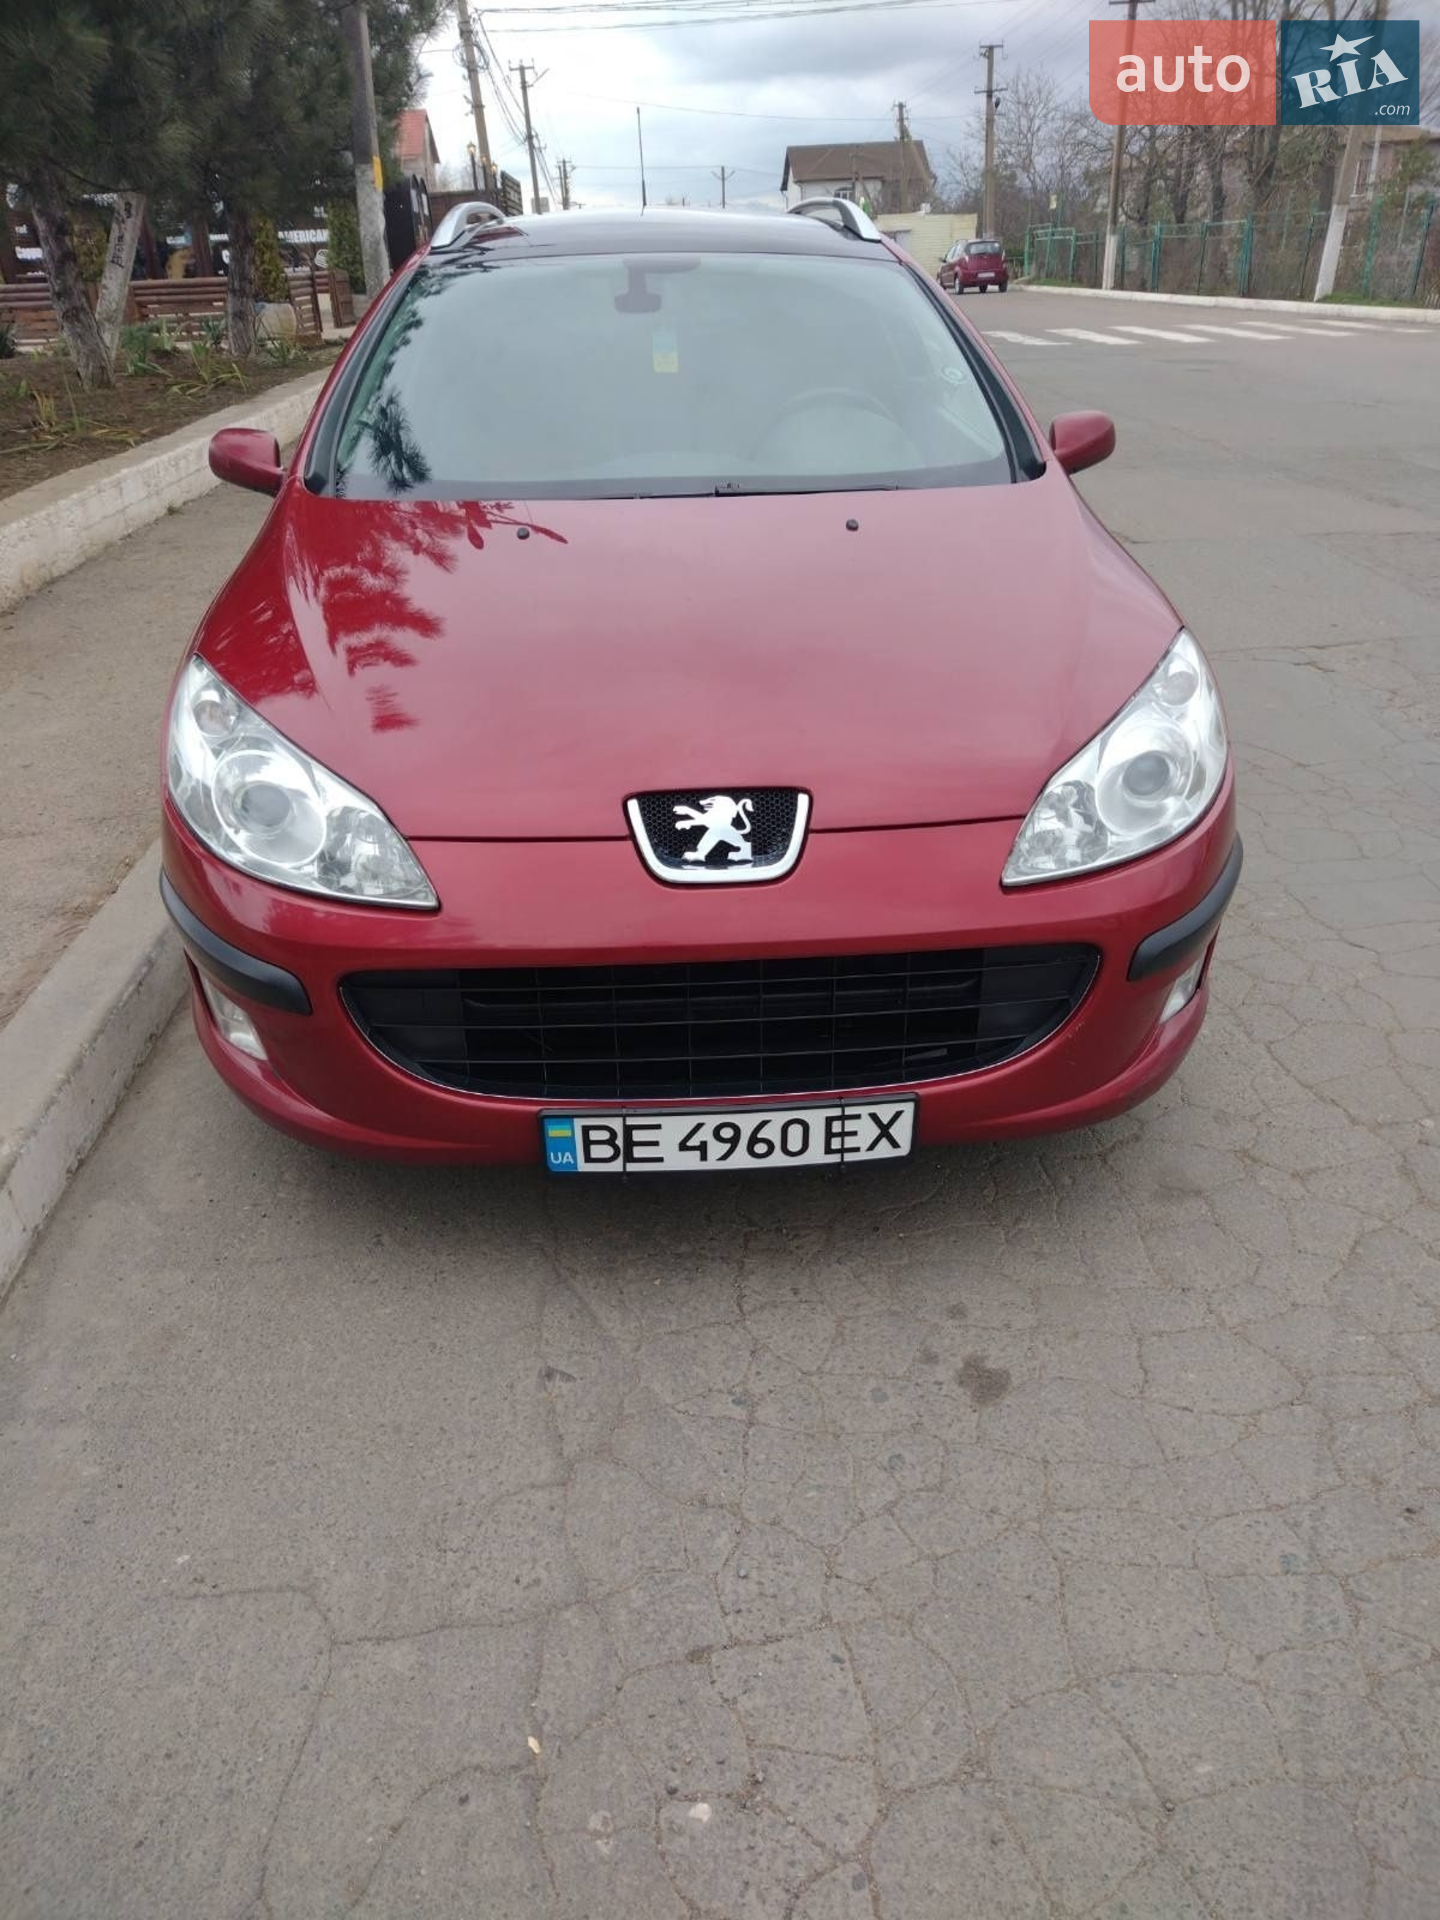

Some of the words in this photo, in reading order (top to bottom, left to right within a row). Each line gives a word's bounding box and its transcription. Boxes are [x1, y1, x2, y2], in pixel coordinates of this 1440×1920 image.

[581, 1123, 664, 1163] BE
[678, 1117, 809, 1162] 4960
[824, 1110, 905, 1155] EX
[550, 1151, 574, 1164] UA
